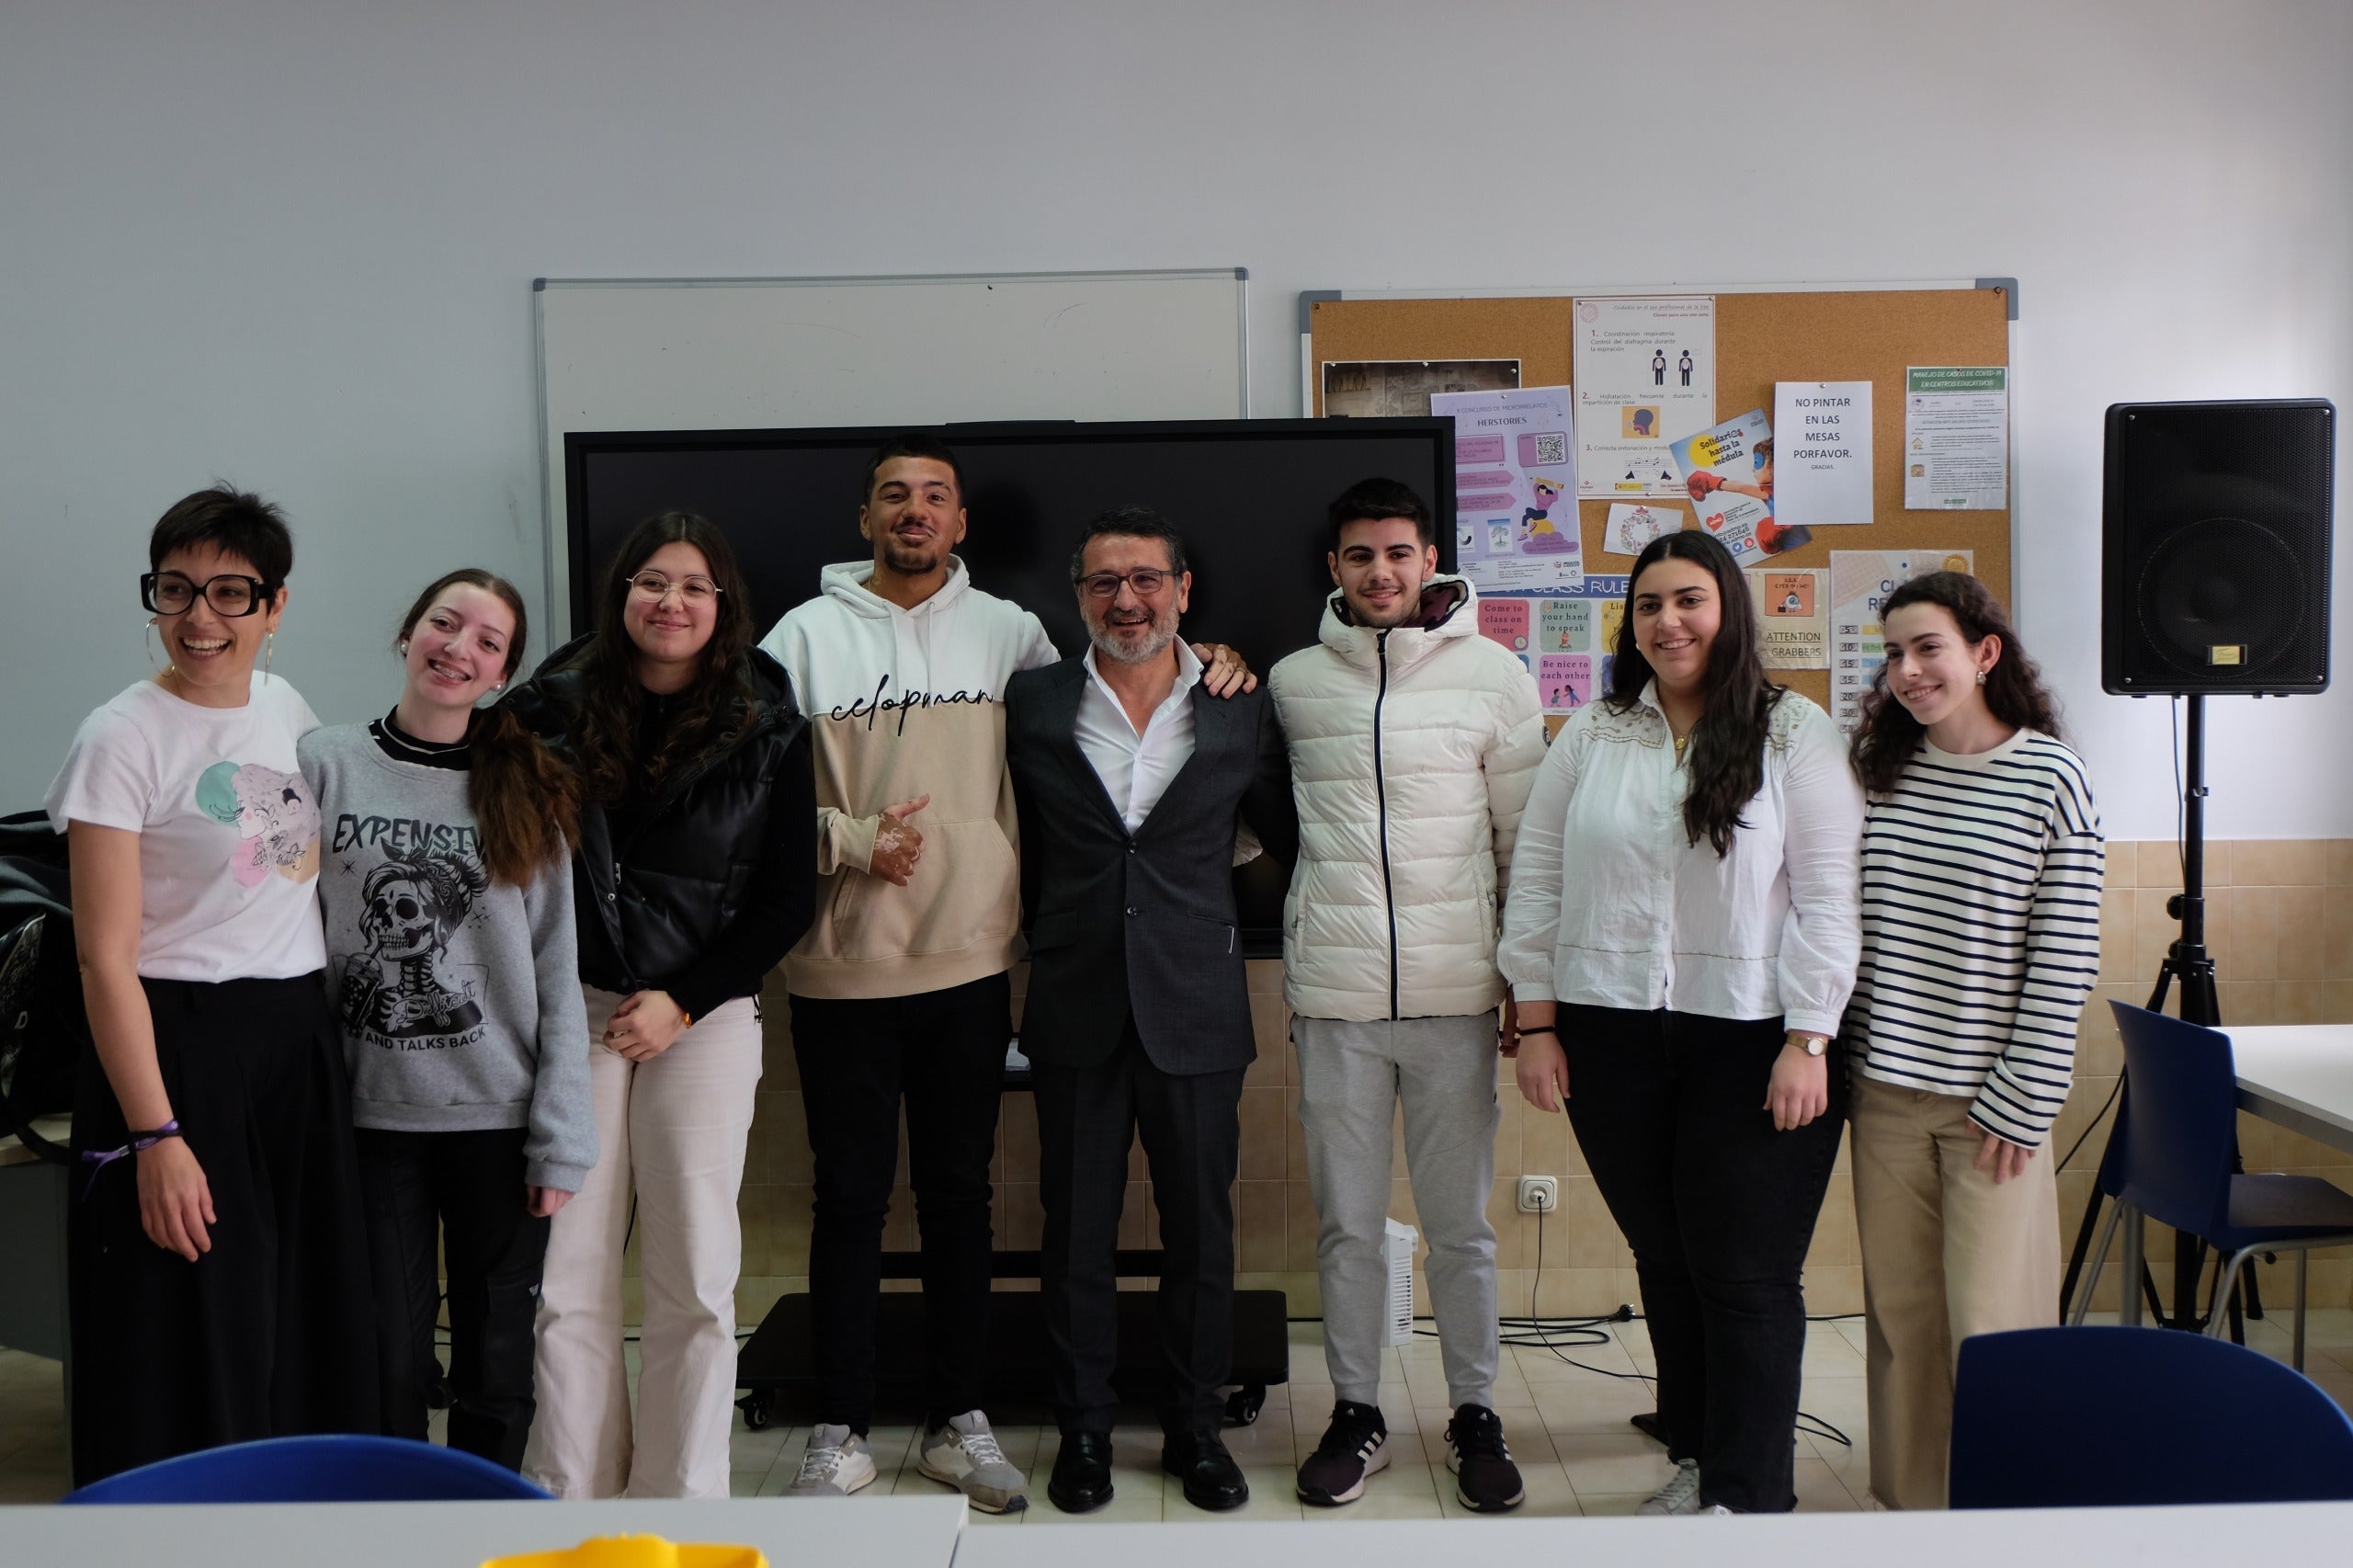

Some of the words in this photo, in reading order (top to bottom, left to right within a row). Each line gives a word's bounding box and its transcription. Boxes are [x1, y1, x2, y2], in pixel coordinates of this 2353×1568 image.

[1795, 398, 1811, 407] NO
[1813, 398, 1851, 407] PINTAR
[1477, 416, 1528, 426] HERSTORIES
[1805, 415, 1819, 424] EN
[1822, 415, 1840, 424] LAS
[1805, 432, 1840, 441] MESAS
[1709, 444, 1732, 457] hasta
[1731, 440, 1741, 449] la
[1713, 449, 1745, 467] médula
[1793, 449, 1853, 459] PORFAVOR.
[1558, 624, 1585, 634] speak
[1767, 632, 1821, 641] ATTENTION
[1772, 647, 1821, 656] GRABBERS
[365, 1031, 393, 1050] AND
[397, 1037, 446, 1051] TALKS
[449, 1026, 487, 1048] BACK
